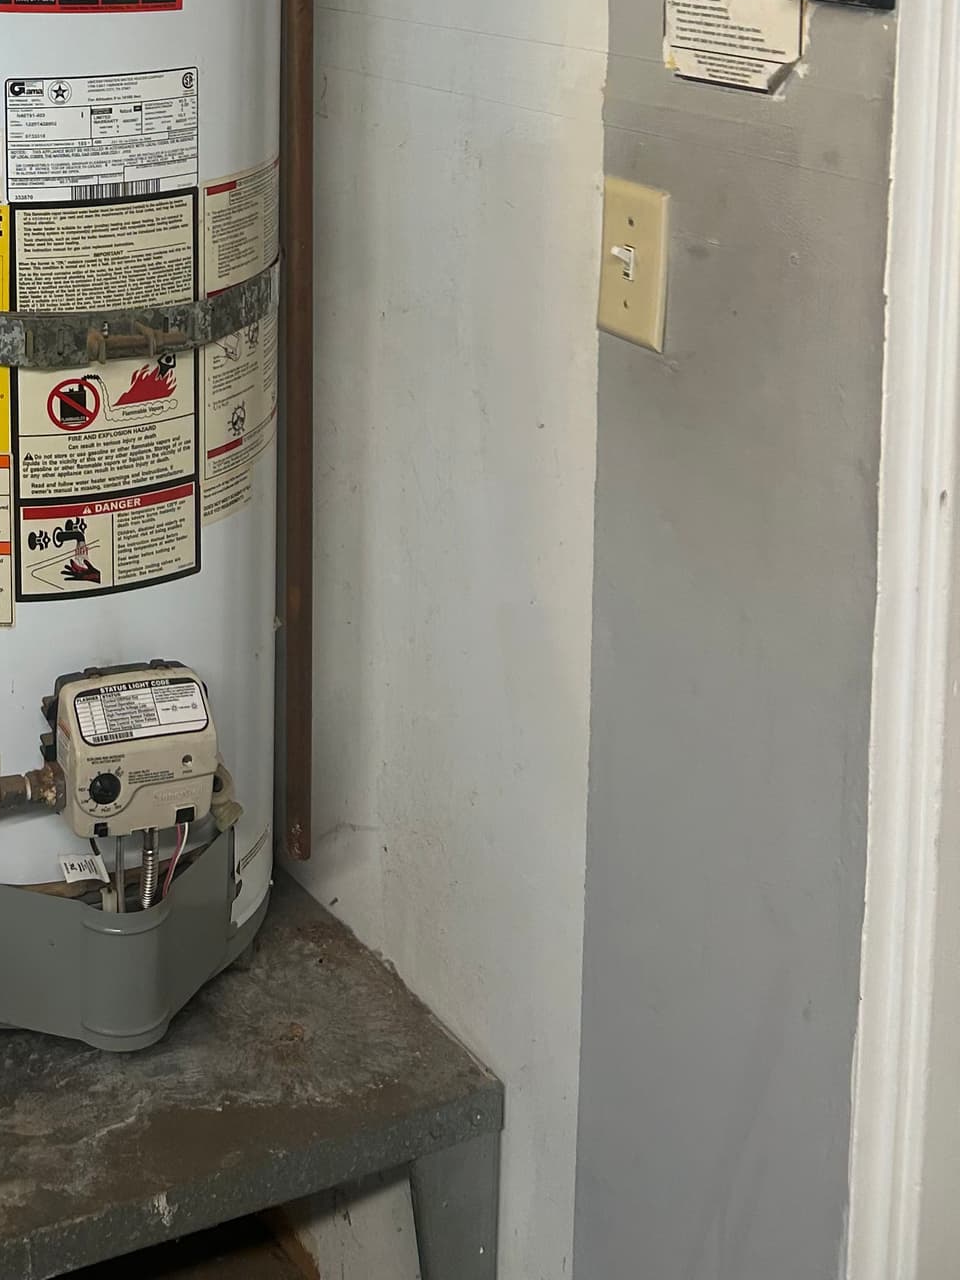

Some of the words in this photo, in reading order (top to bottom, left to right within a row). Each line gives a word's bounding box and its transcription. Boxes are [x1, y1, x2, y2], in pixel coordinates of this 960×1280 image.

[93, 250, 124, 258] IMPORTANT
[148, 404, 164, 413] Vapors
[98, 428, 132, 439] EXPLOSION
[133, 424, 157, 434] HAZARD
[95, 498, 141, 513] DANGER
[100, 684, 128, 694] STATUS
[128, 681, 149, 690] LIGHT
[150, 679, 170, 687] CODE
